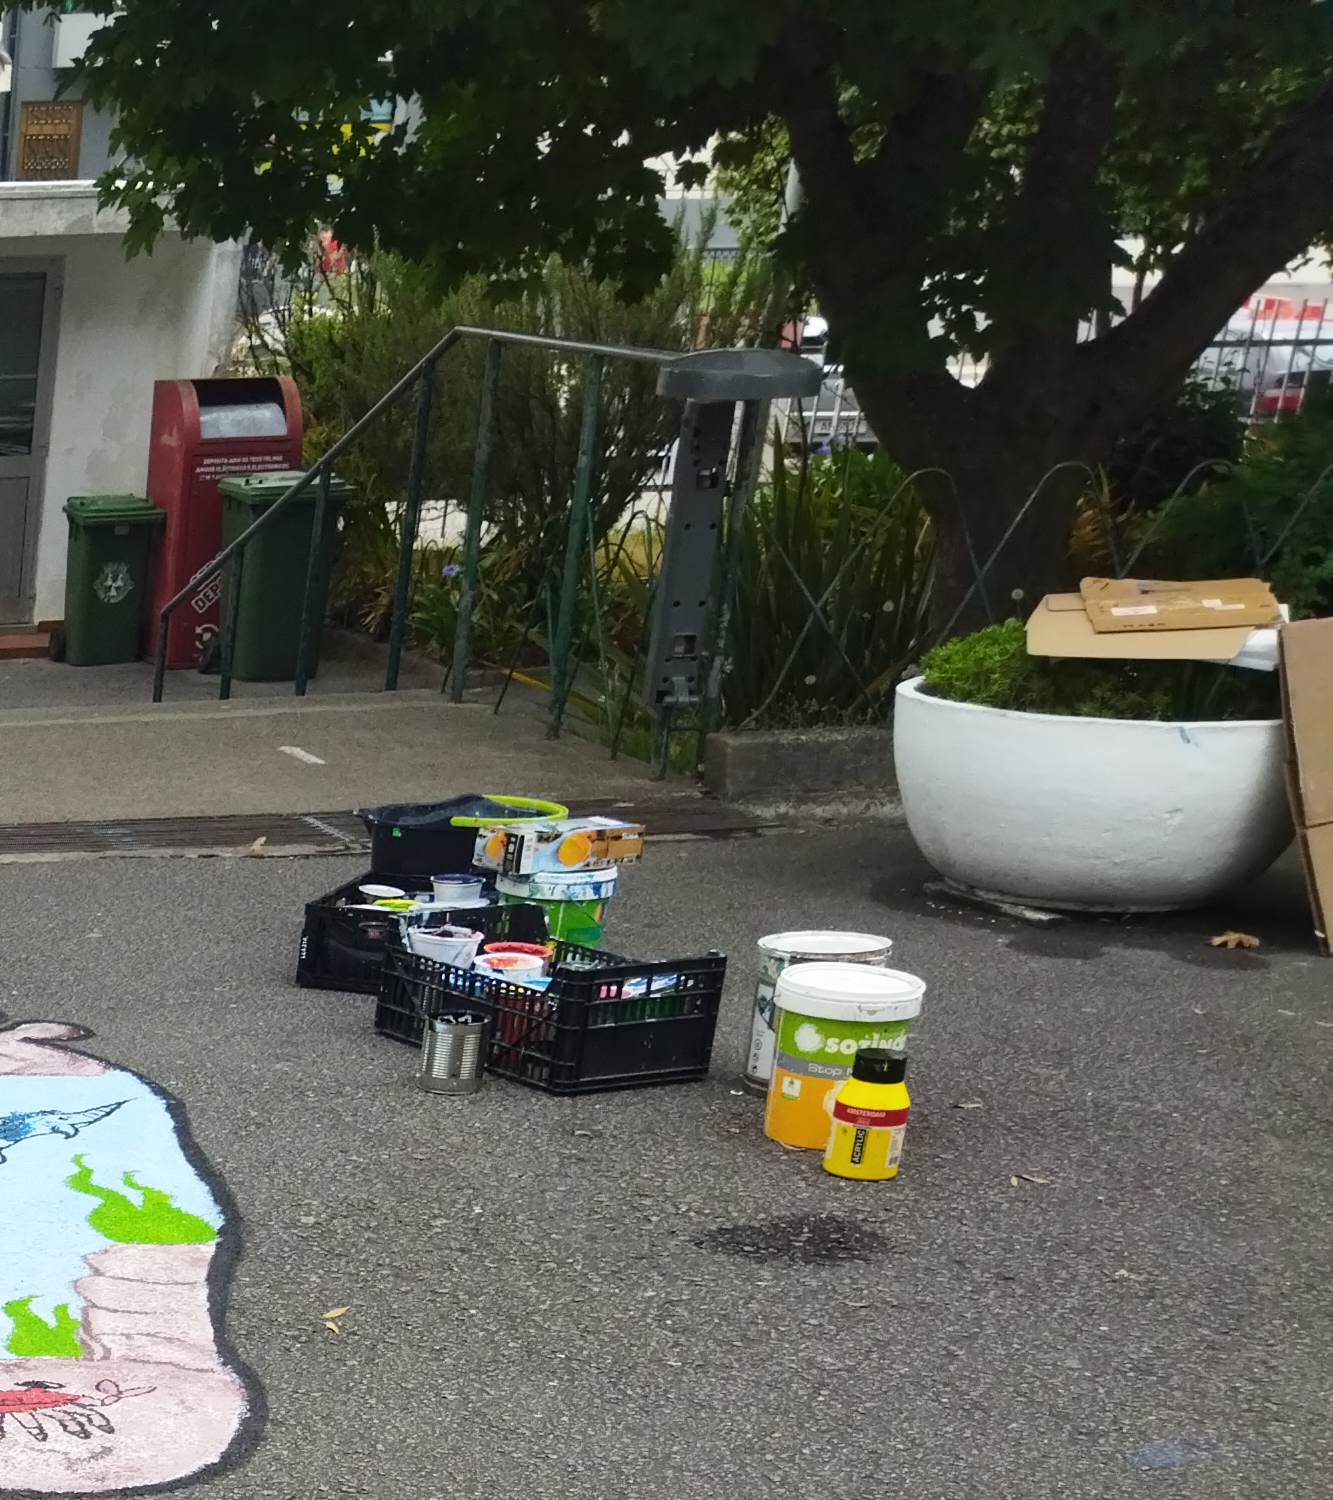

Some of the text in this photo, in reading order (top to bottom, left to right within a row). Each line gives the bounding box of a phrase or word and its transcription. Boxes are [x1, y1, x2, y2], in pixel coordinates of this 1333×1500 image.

[191, 583, 221, 614] DEP
[807, 1062, 843, 1077] Stop
[851, 1128, 866, 1164] ACRYLIC
